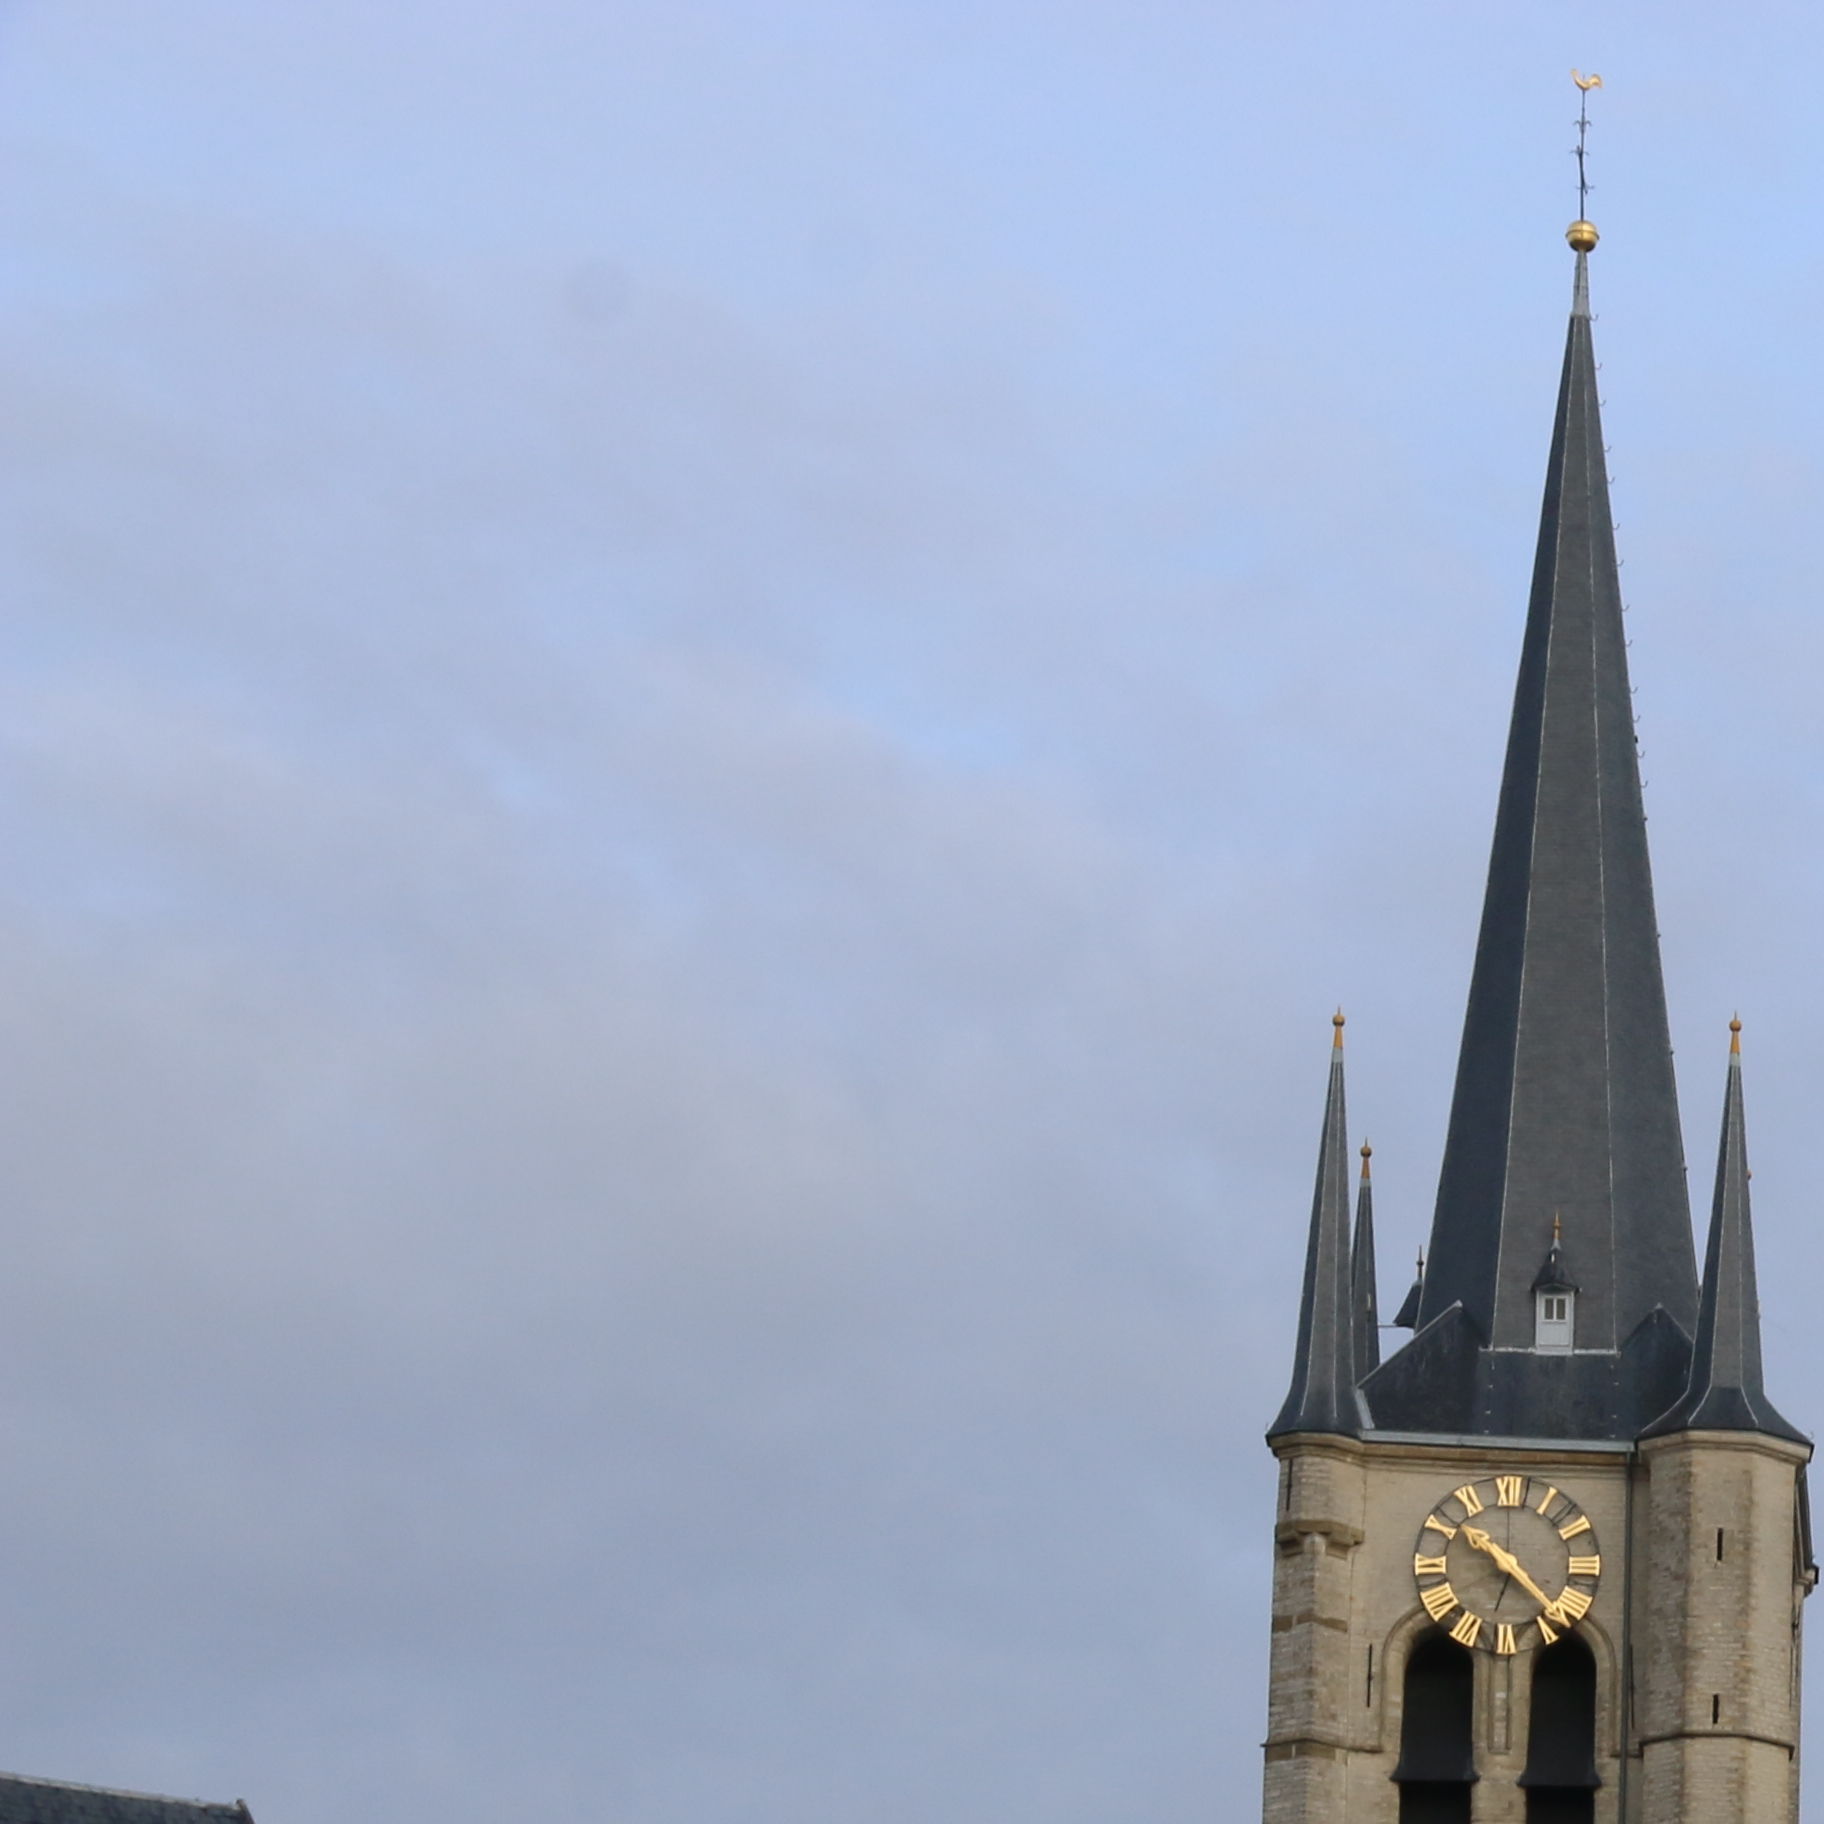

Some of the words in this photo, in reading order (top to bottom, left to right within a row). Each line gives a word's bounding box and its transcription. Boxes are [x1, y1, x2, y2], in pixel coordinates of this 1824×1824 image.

[1454, 1485, 1484, 1517] XI
[1496, 1476, 1522, 1507] XII
[1536, 1486, 1558, 1515] I
[1424, 1514, 1457, 1540] X
[1559, 1515, 1592, 1540] II
[1415, 1553, 1447, 1576] IX
[1568, 1554, 1600, 1576] III
[1420, 1582, 1459, 1622] VIII
[1449, 1610, 1483, 1647] VII
[1496, 1623, 1517, 1654] VI
[1536, 1615, 1560, 1645] V
